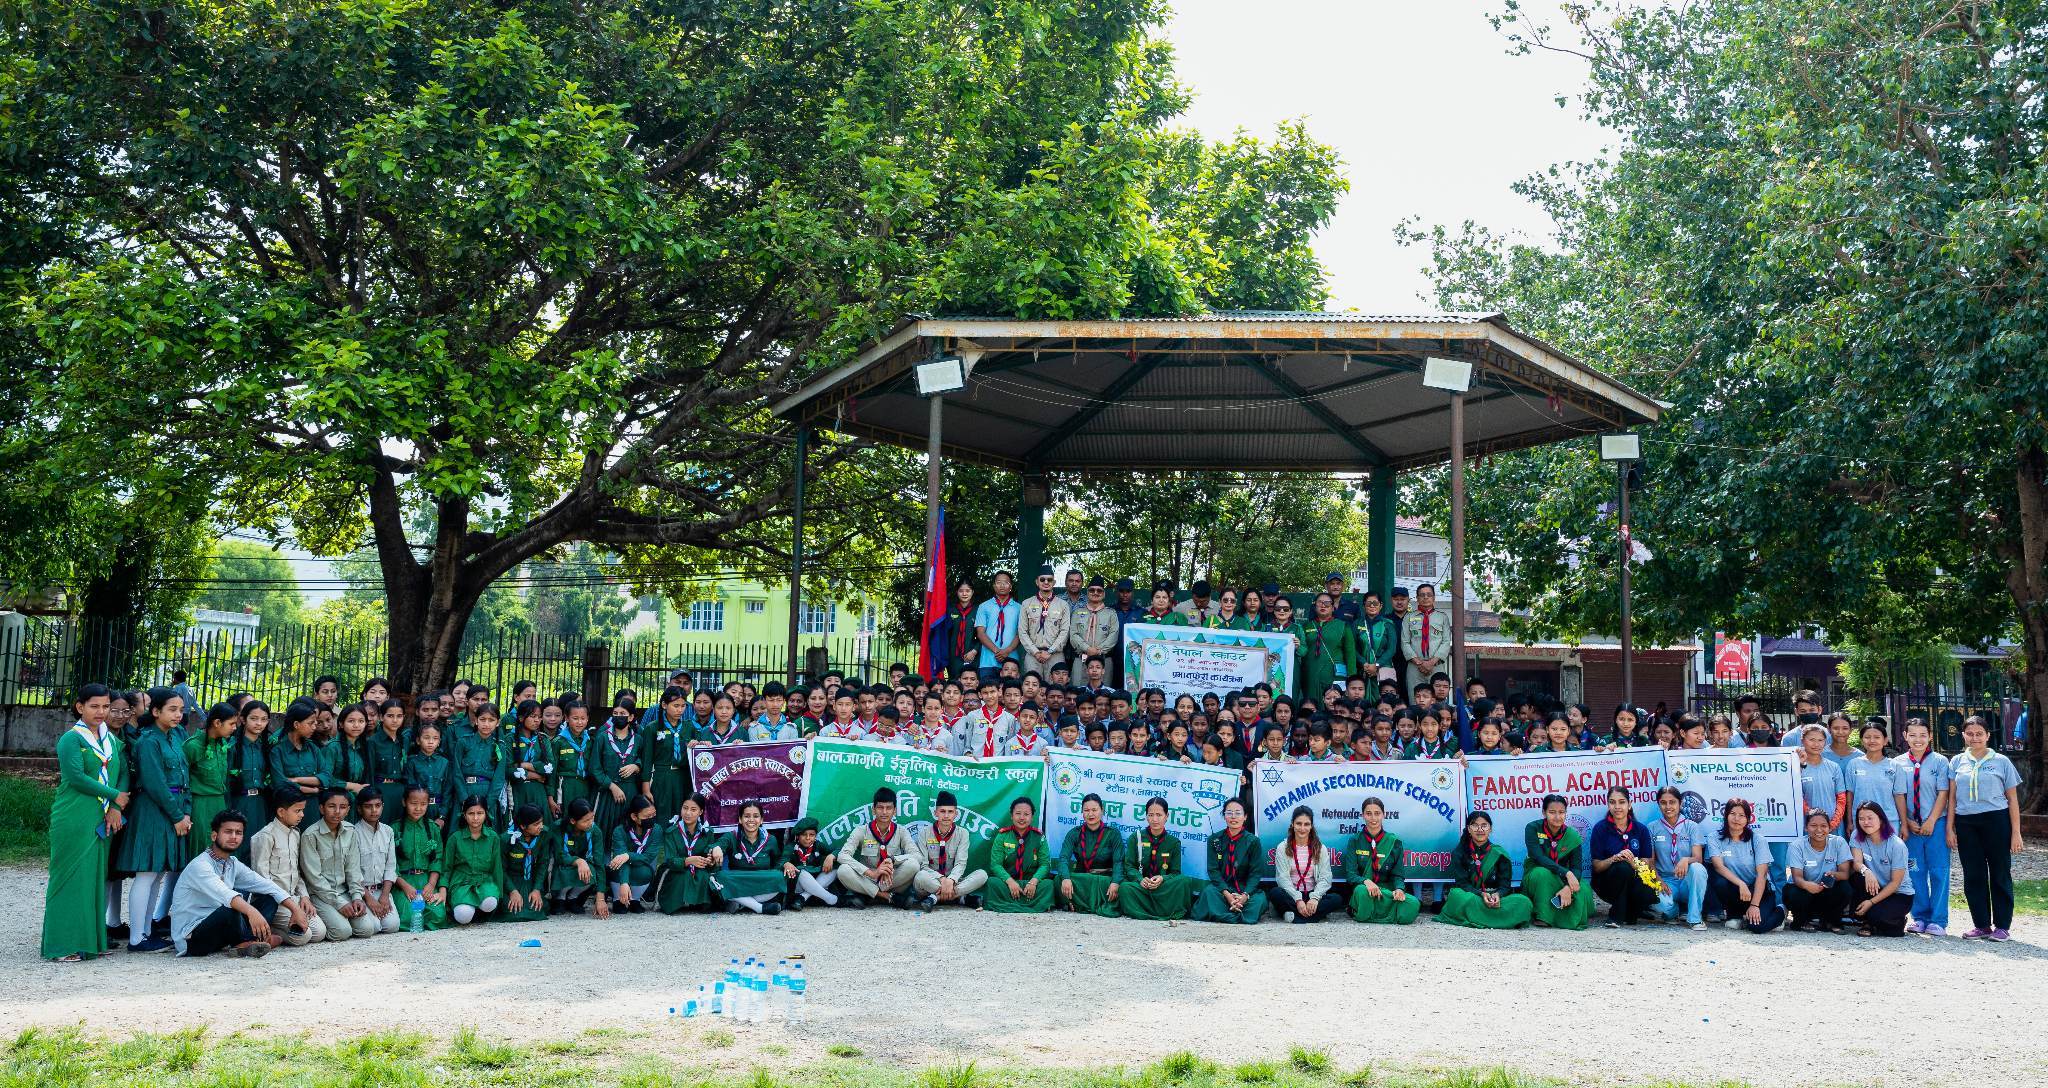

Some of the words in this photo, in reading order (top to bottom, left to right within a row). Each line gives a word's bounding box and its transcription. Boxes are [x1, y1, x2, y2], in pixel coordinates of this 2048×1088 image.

[1172, 646, 1203, 658] नेपाल
[1210, 650, 1247, 661] स्काउट
[816, 750, 886, 769] बालजागृति
[1690, 763, 1732, 774] NEPAL
[1736, 761, 1788, 773] SCOUTS
[710, 766, 731, 785] बाल
[1472, 773, 1559, 796] FAMCOL
[1565, 767, 1660, 792] ACADEMY
[1263, 780, 1322, 822] SHRAMIK
[1322, 773, 1404, 793] SECONDARY
[1405, 783, 1456, 823] SCHOOL
[1628, 790, 1658, 804] CHOO
[1321, 808, 1364, 819] Hetauda-
[1402, 849, 1451, 871] Troop
